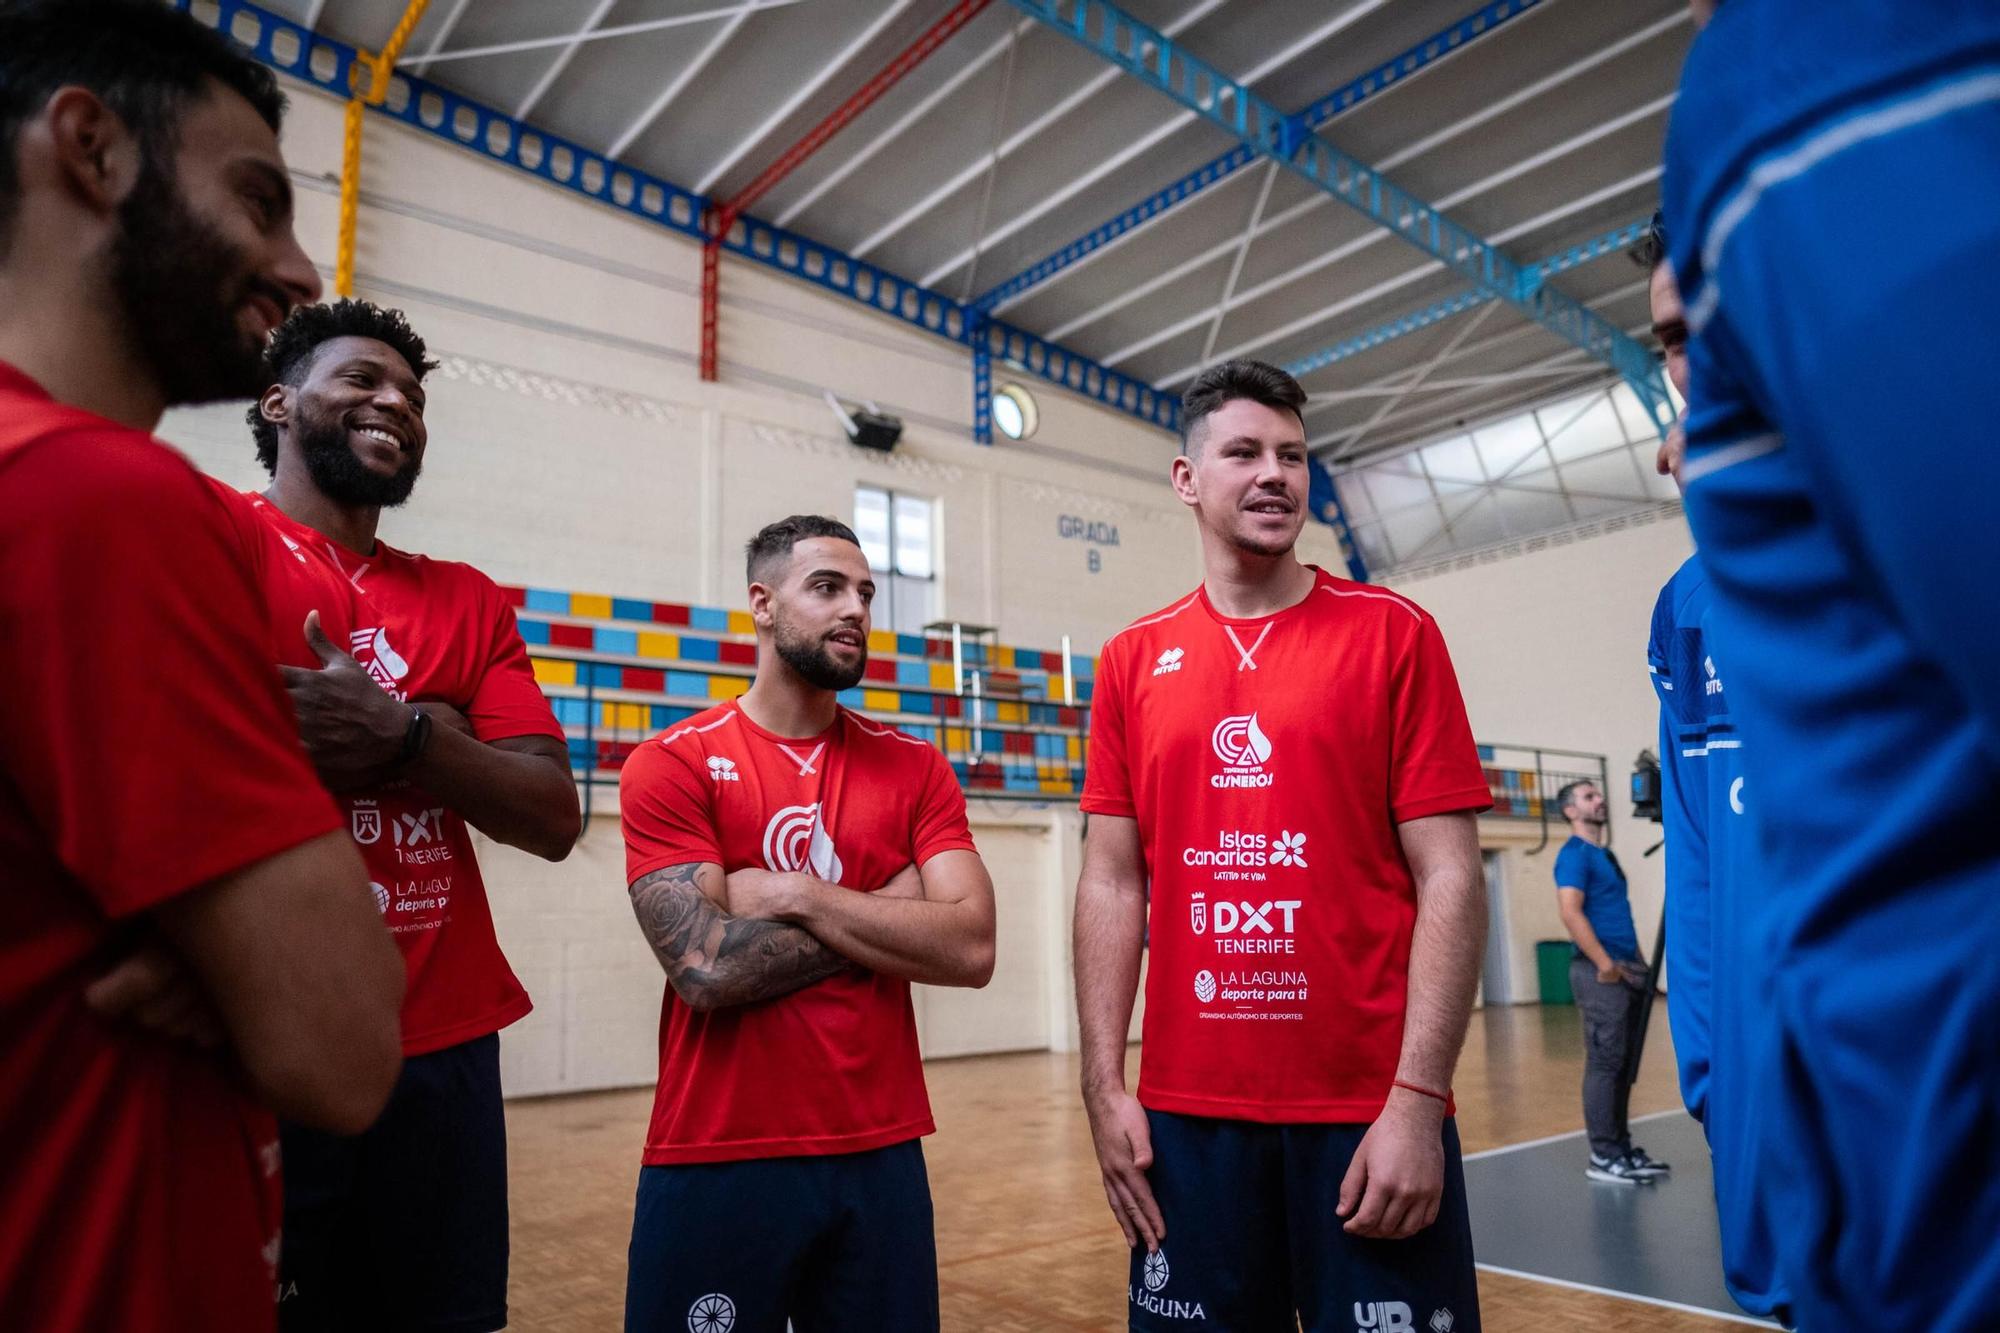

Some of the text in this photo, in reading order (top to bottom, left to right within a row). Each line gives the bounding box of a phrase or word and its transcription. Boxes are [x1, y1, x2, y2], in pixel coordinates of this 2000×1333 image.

[1057, 513, 1120, 546] GRADA
[1087, 550, 1102, 574] B
[1210, 773, 1274, 788] CISNEROS
[1219, 830, 1267, 849] Islas
[1183, 847, 1267, 867] Canarias
[1214, 871, 1267, 881] LATITUD DE VIDA
[1213, 900, 1302, 934] DXT
[1214, 939, 1295, 954] TENERIFE
[1220, 971, 1308, 985] LA LAGUNA
[1221, 987, 1307, 1002] deporte para ti
[1136, 1287, 1207, 1320] LAGUNA
